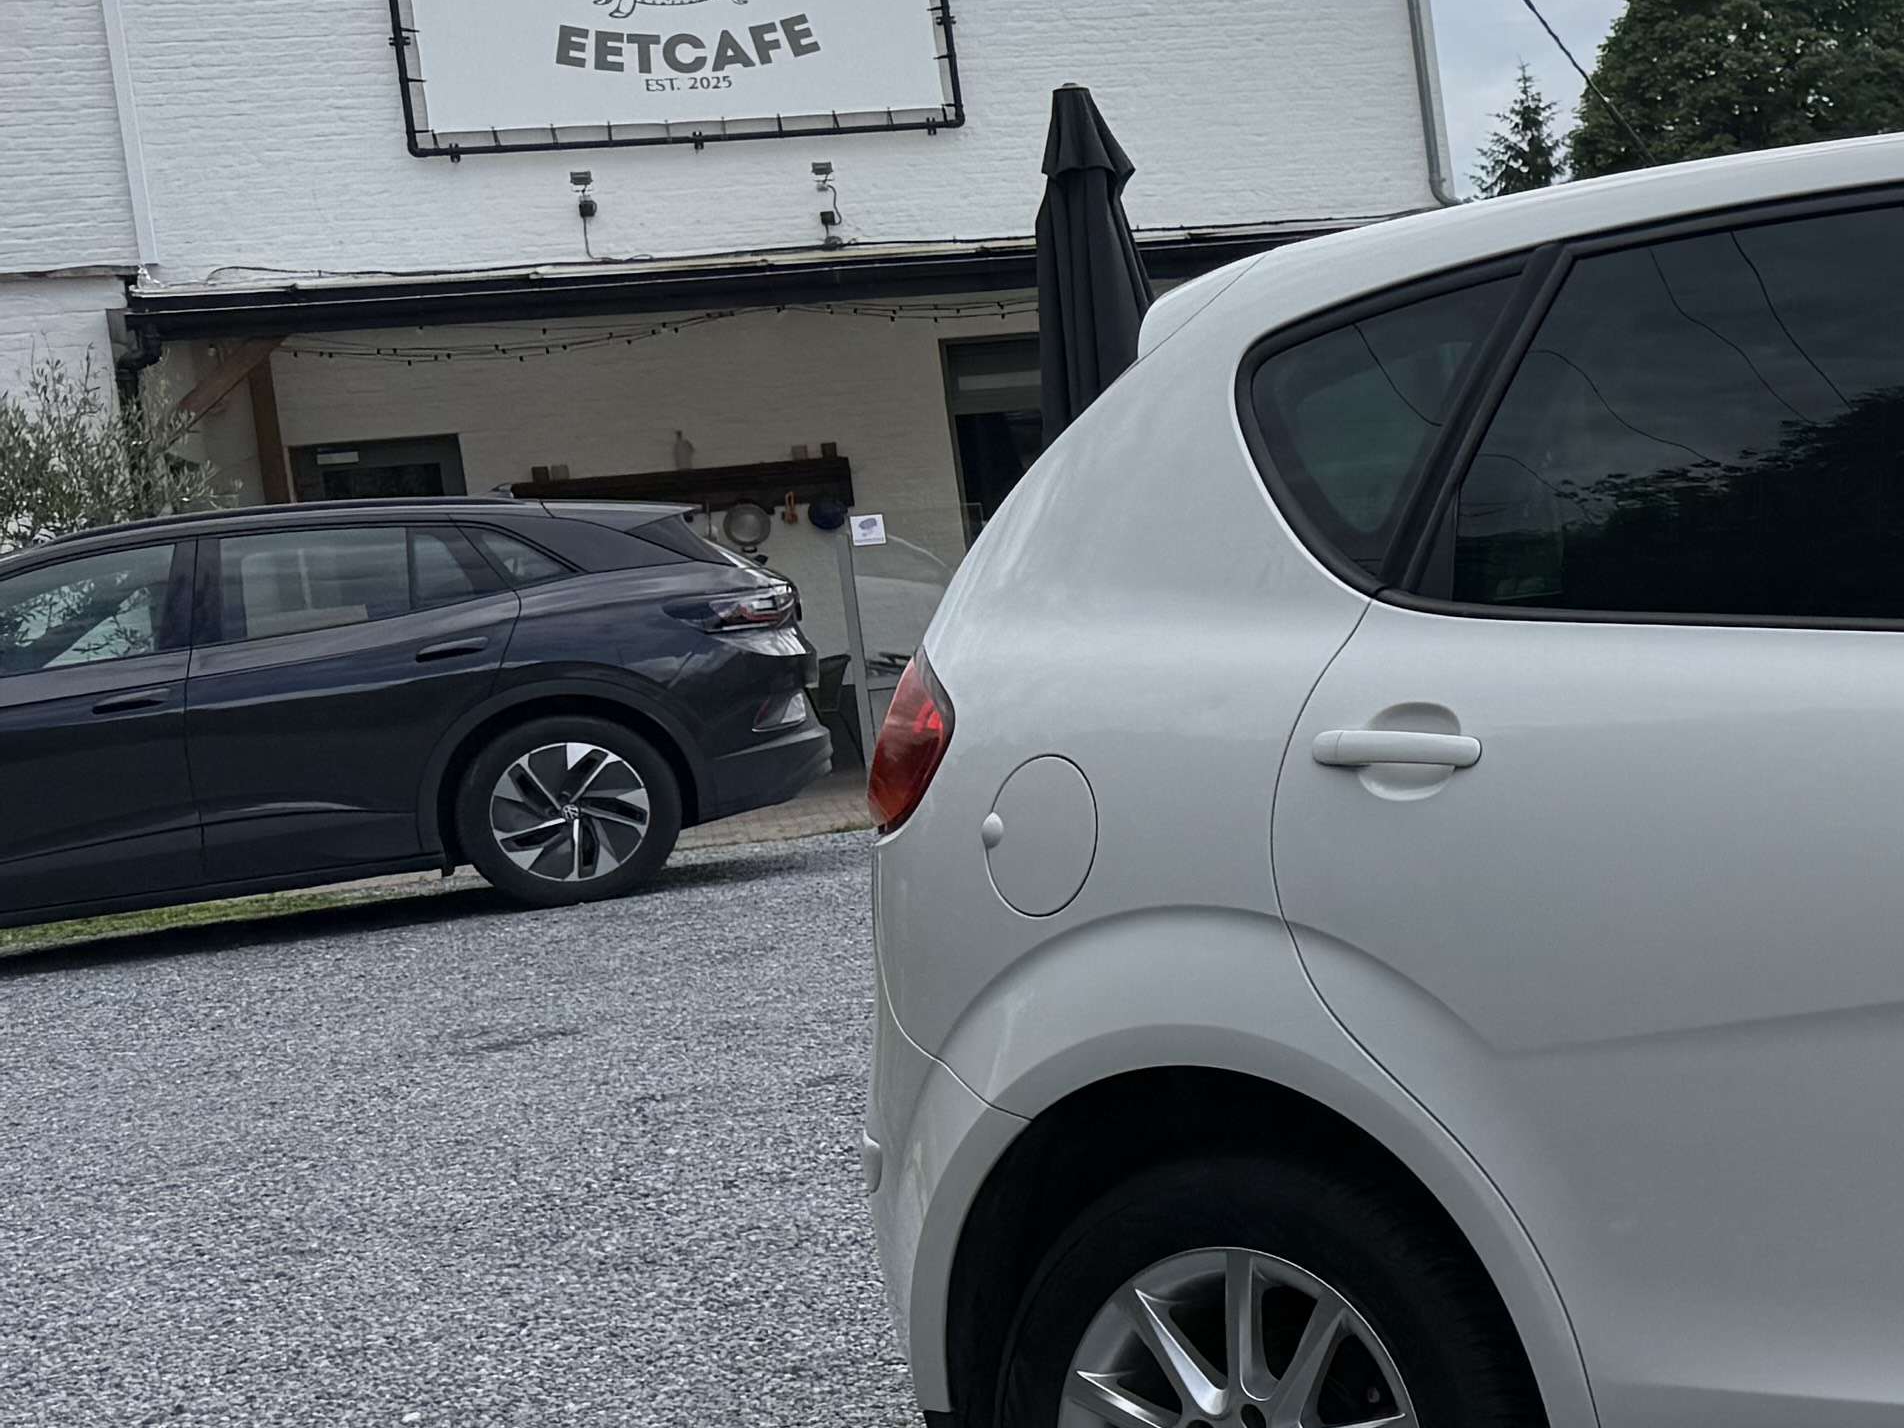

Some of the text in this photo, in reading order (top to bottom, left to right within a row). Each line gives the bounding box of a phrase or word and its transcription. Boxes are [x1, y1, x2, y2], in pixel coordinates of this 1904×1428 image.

[555, 13, 821, 74] EETCAFE
[644, 74, 733, 92] EST. 2025
